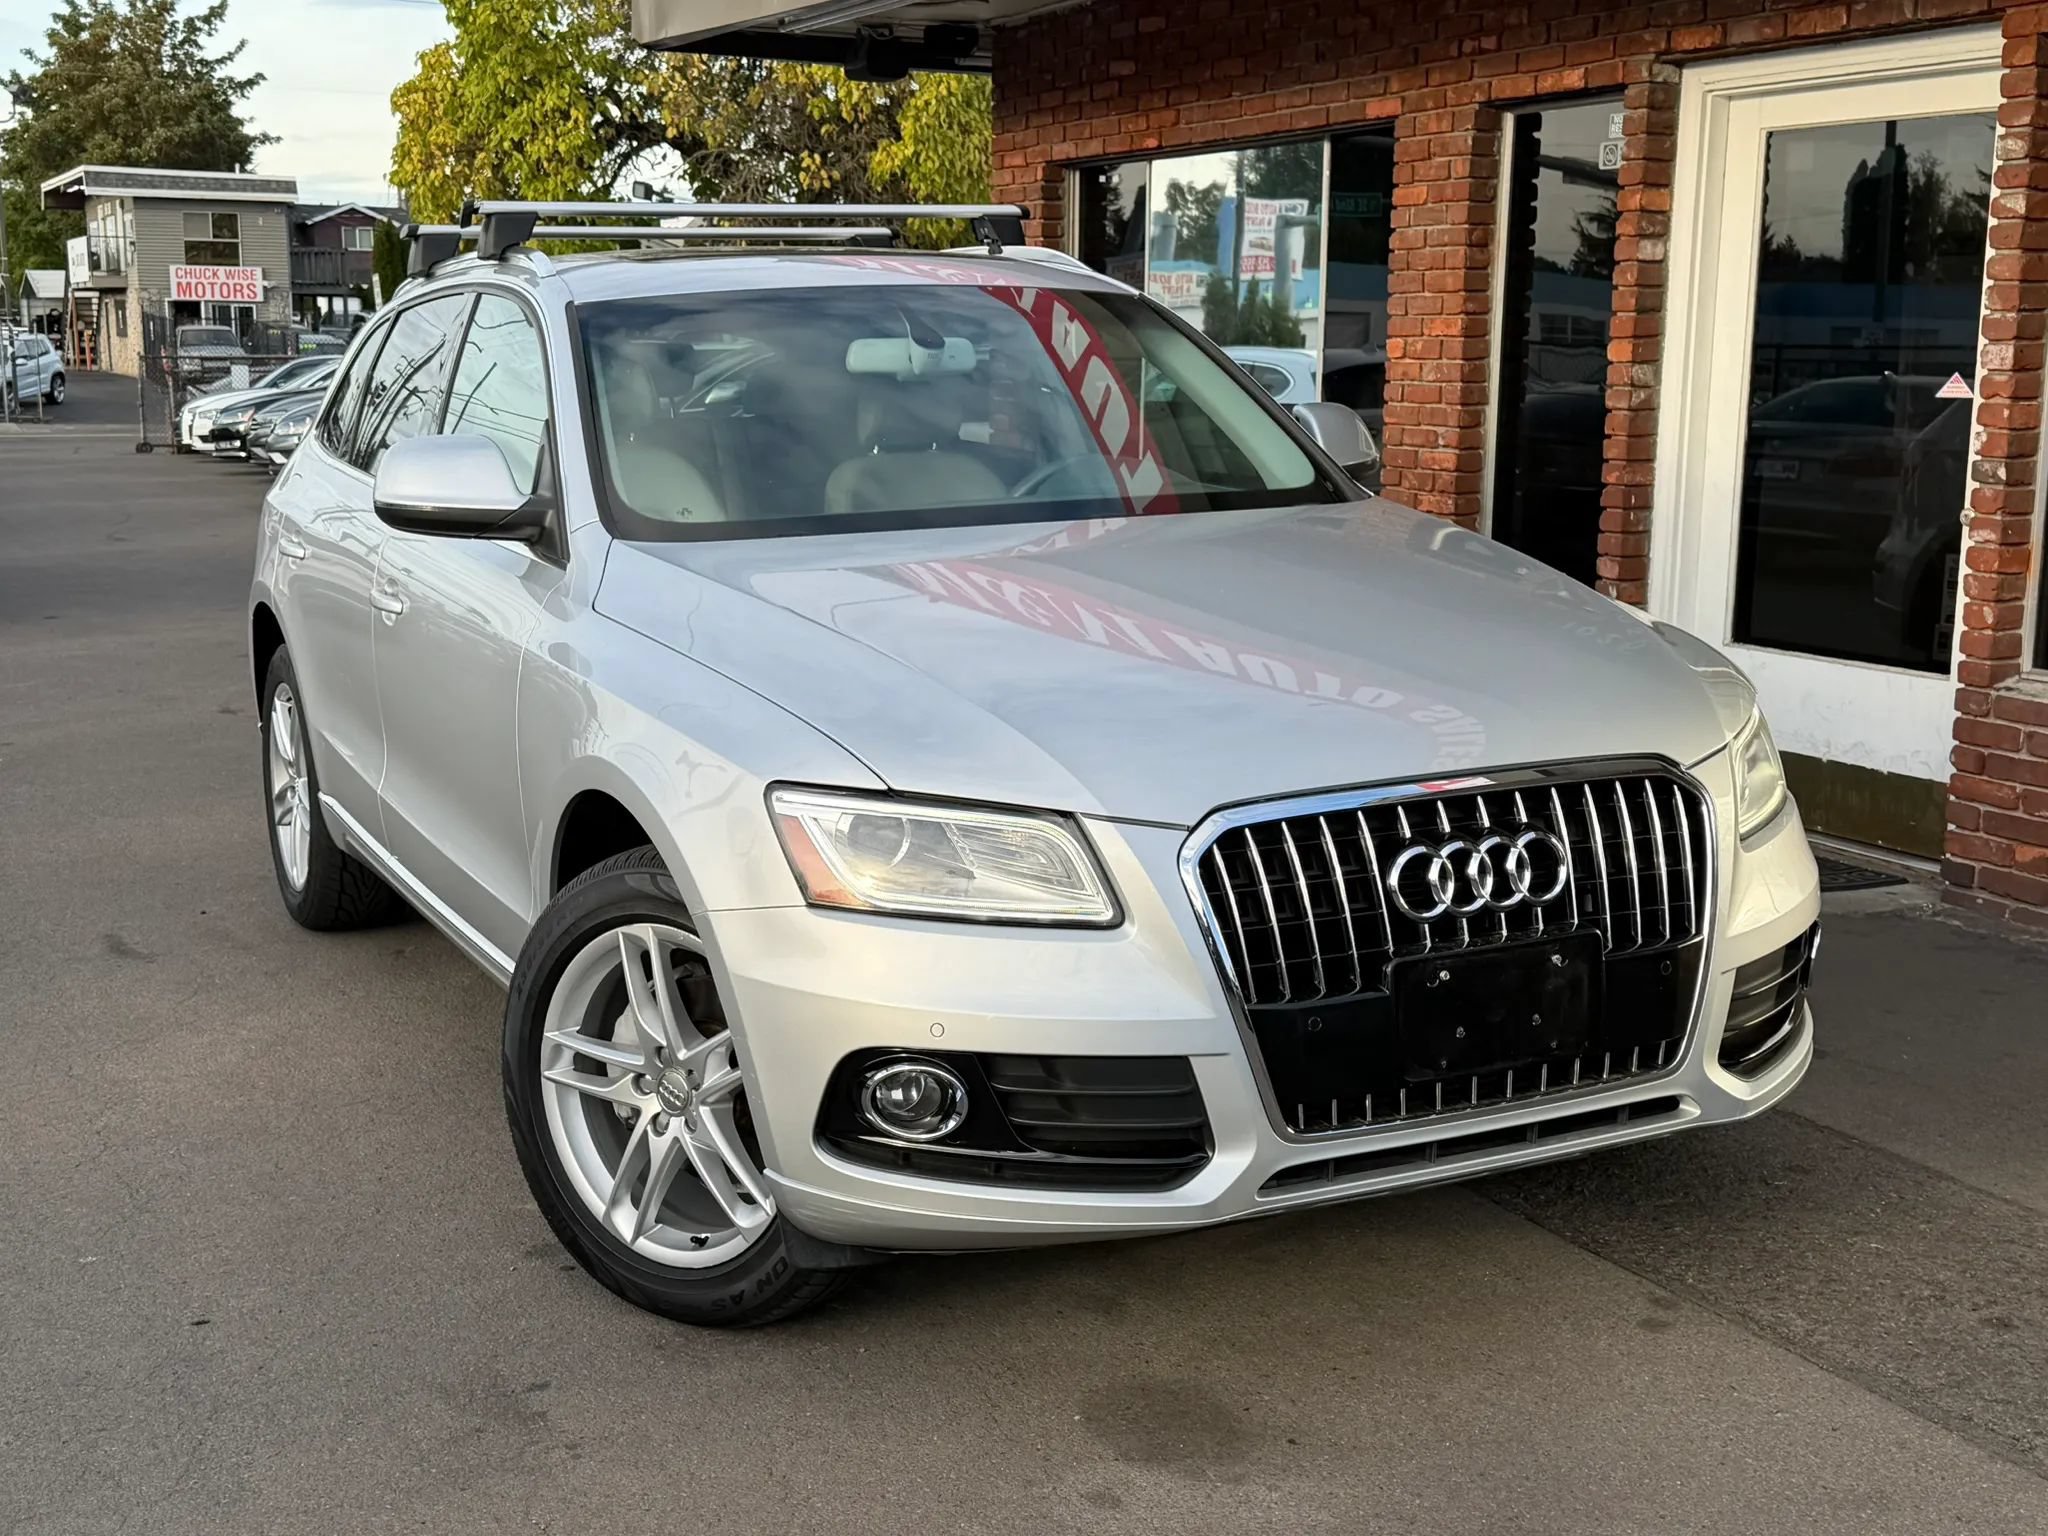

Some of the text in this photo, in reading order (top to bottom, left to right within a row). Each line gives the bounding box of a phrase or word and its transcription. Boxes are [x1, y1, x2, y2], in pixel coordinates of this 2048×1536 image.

[175, 266, 257, 281] CHUCK WISE
[176, 281, 257, 299] MOTORS
